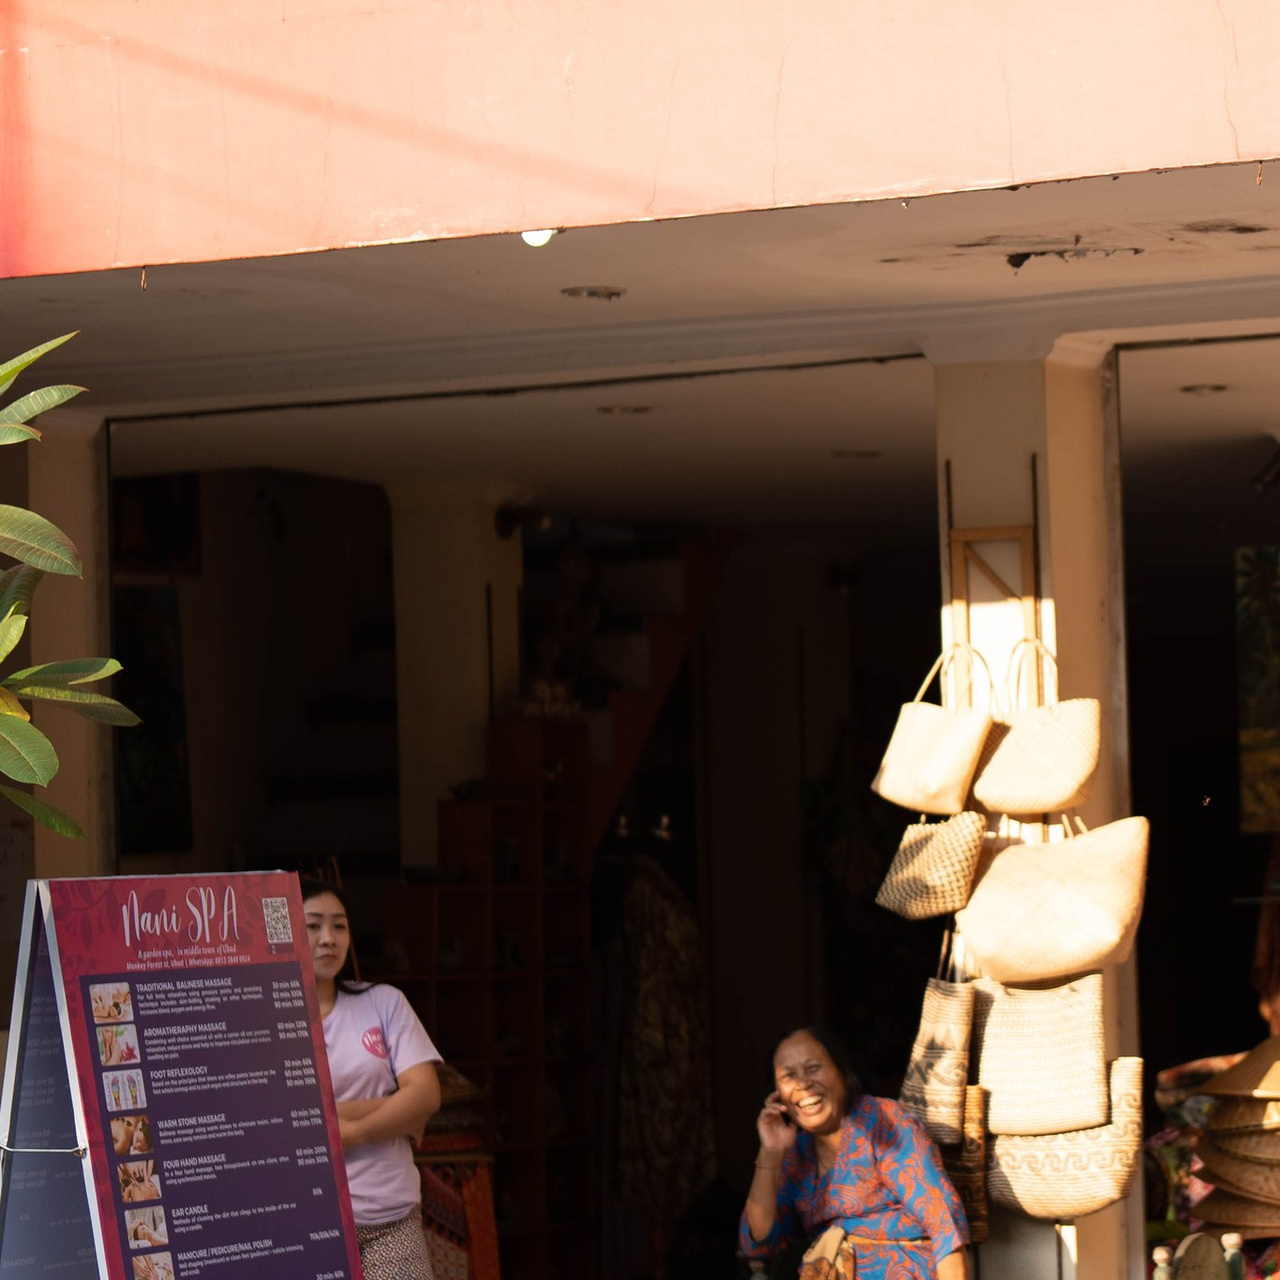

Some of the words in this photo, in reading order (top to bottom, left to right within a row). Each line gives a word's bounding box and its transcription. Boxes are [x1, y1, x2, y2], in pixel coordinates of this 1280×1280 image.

[122, 891, 180, 945] Nani
[143, 948, 162, 961] garden
[162, 950, 173, 959] spa,
[184, 945, 202, 958] middle
[202, 946, 217, 958] town
[222, 943, 237, 956] Ubud
[136, 982, 175, 992] TRADITIONAL
[176, 979, 204, 989] BALINESE
[204, 977, 232, 987] MASSAGE
[198, 1022, 227, 1032] MASSAGE
[150, 1070, 166, 1079] FOOT
[167, 1066, 207, 1077] REFLEXOLOGY
[157, 1119, 177, 1129] WARM
[178, 1117, 197, 1127] STONE
[198, 1113, 226, 1124] MASSAGE
[163, 1159, 180, 1169] FOUR
[180, 1157, 198, 1167] HAND
[198, 1153, 226, 1164] MASSAGE
[171, 1208, 185, 1217] EAR
[185, 1204, 208, 1215] CANDLE
[177, 1249, 207, 1261] MANICURE
[211, 1242, 252, 1255] PEDICURE/NAIL
[252, 1239, 273, 1249] POLISH
